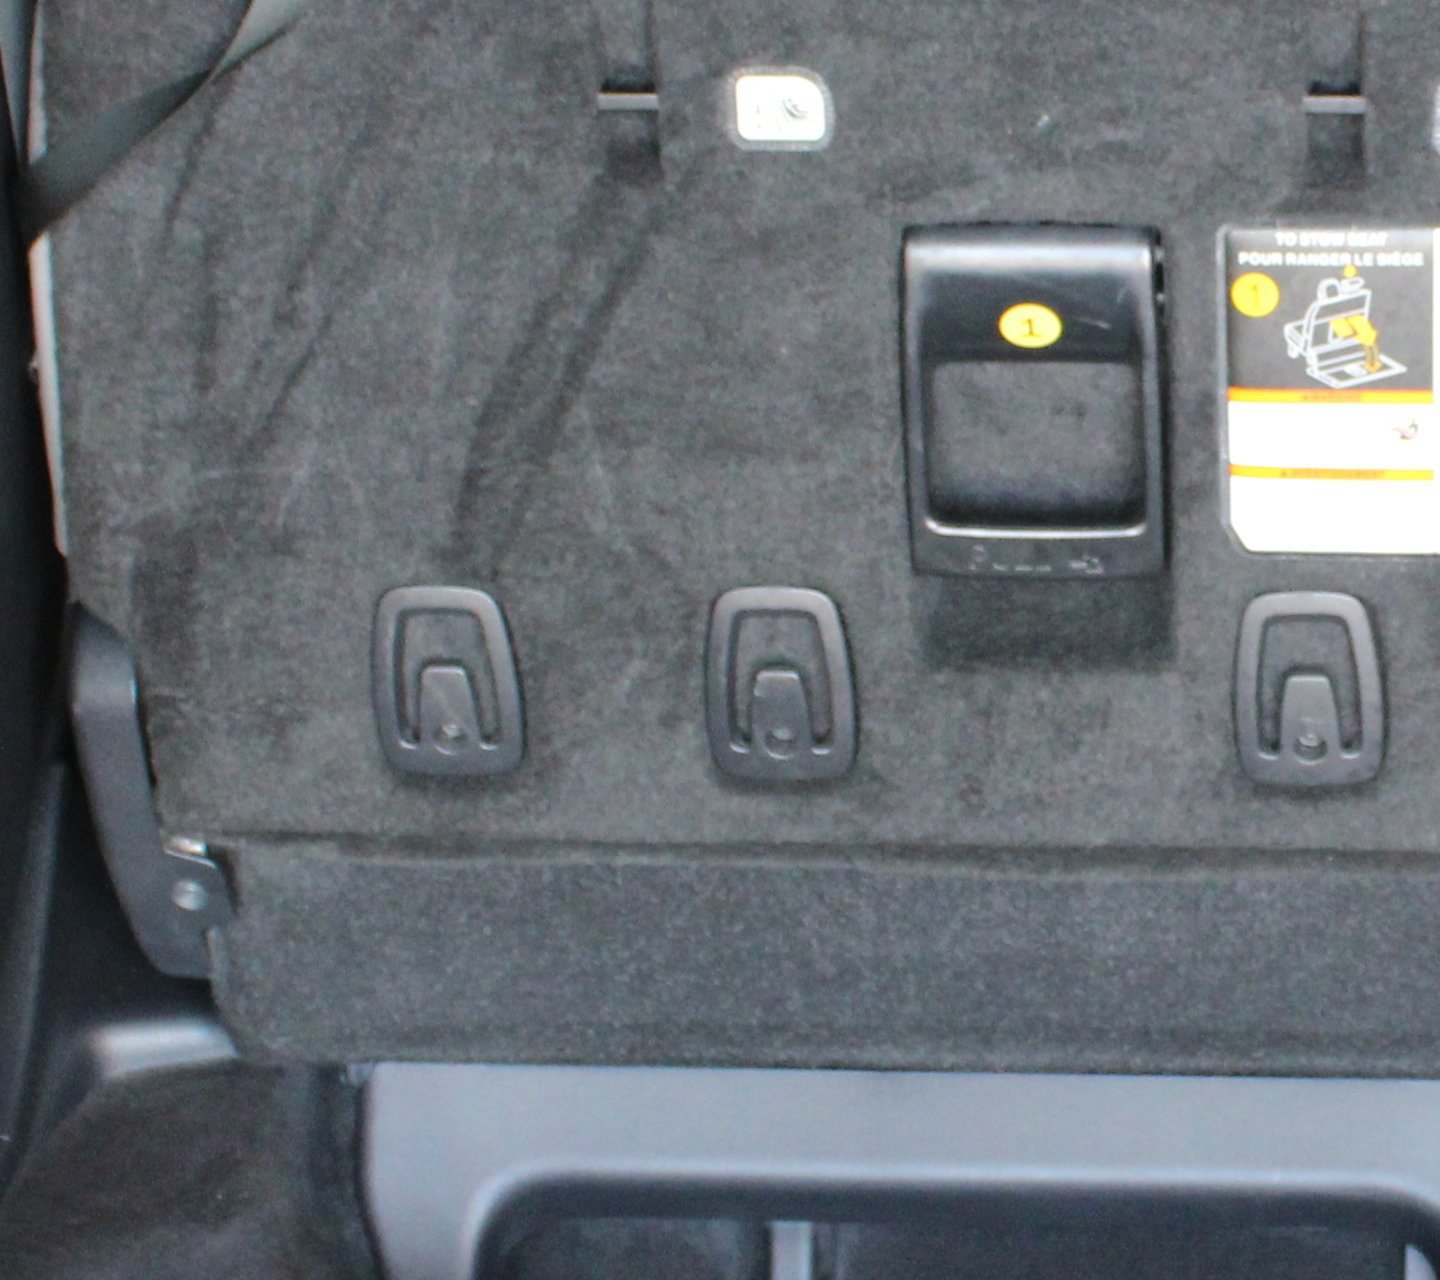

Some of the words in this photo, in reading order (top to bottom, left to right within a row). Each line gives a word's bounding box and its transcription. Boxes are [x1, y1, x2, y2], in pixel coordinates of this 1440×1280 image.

[1275, 232, 1297, 246] TO
[1238, 251, 1283, 266] POUR
[1285, 251, 1351, 266] RANGER
[1354, 252, 1374, 266] LE
[1021, 317, 1044, 338] 1
